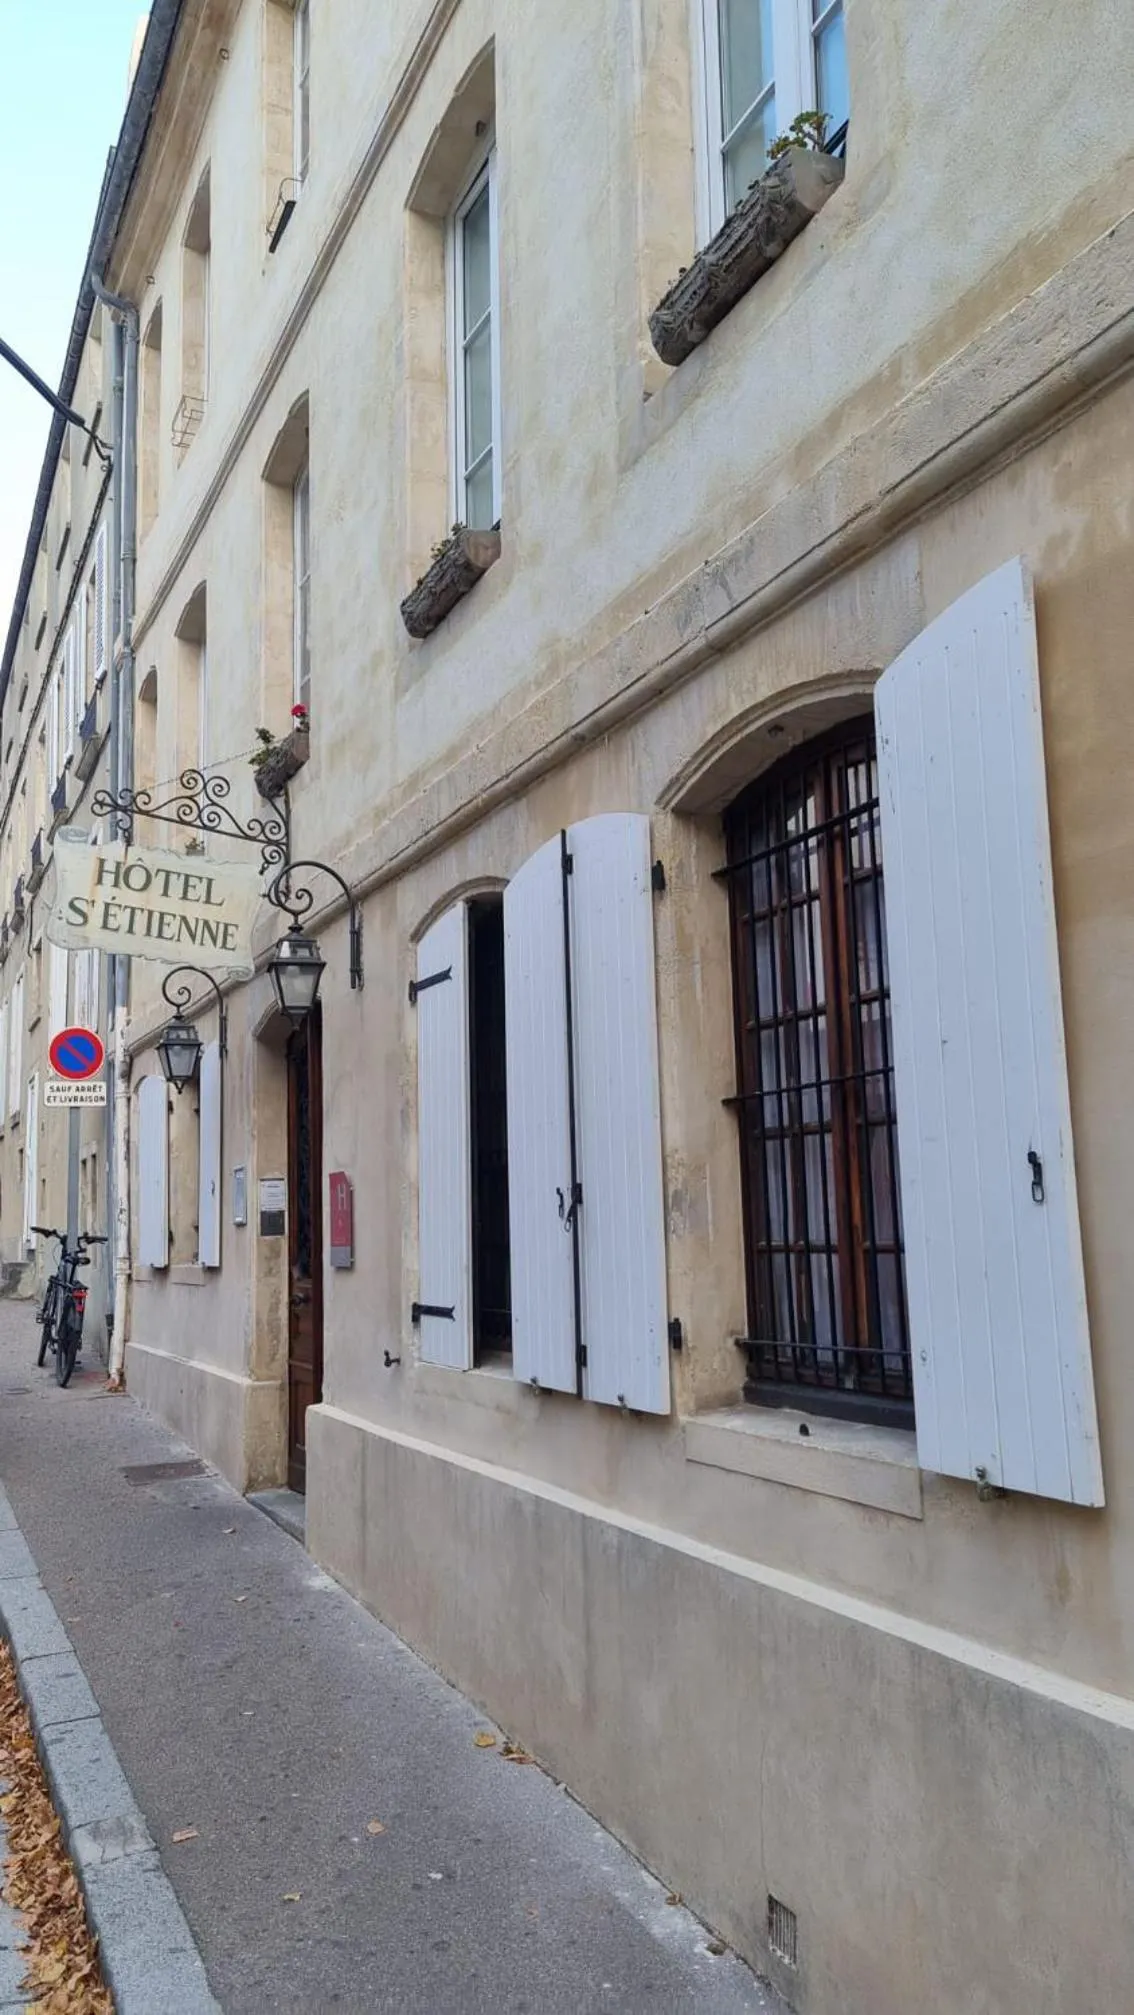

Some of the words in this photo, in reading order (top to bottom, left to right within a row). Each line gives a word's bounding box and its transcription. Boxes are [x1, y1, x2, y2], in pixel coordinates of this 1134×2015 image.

[95, 857, 225, 907] HÔTEL
[49, 1084, 72, 1093] SAUF
[75, 1083, 103, 1093] ARRÊT
[46, 1095, 57, 1103] ET
[60, 1095, 105, 1103] LIVRAISON
